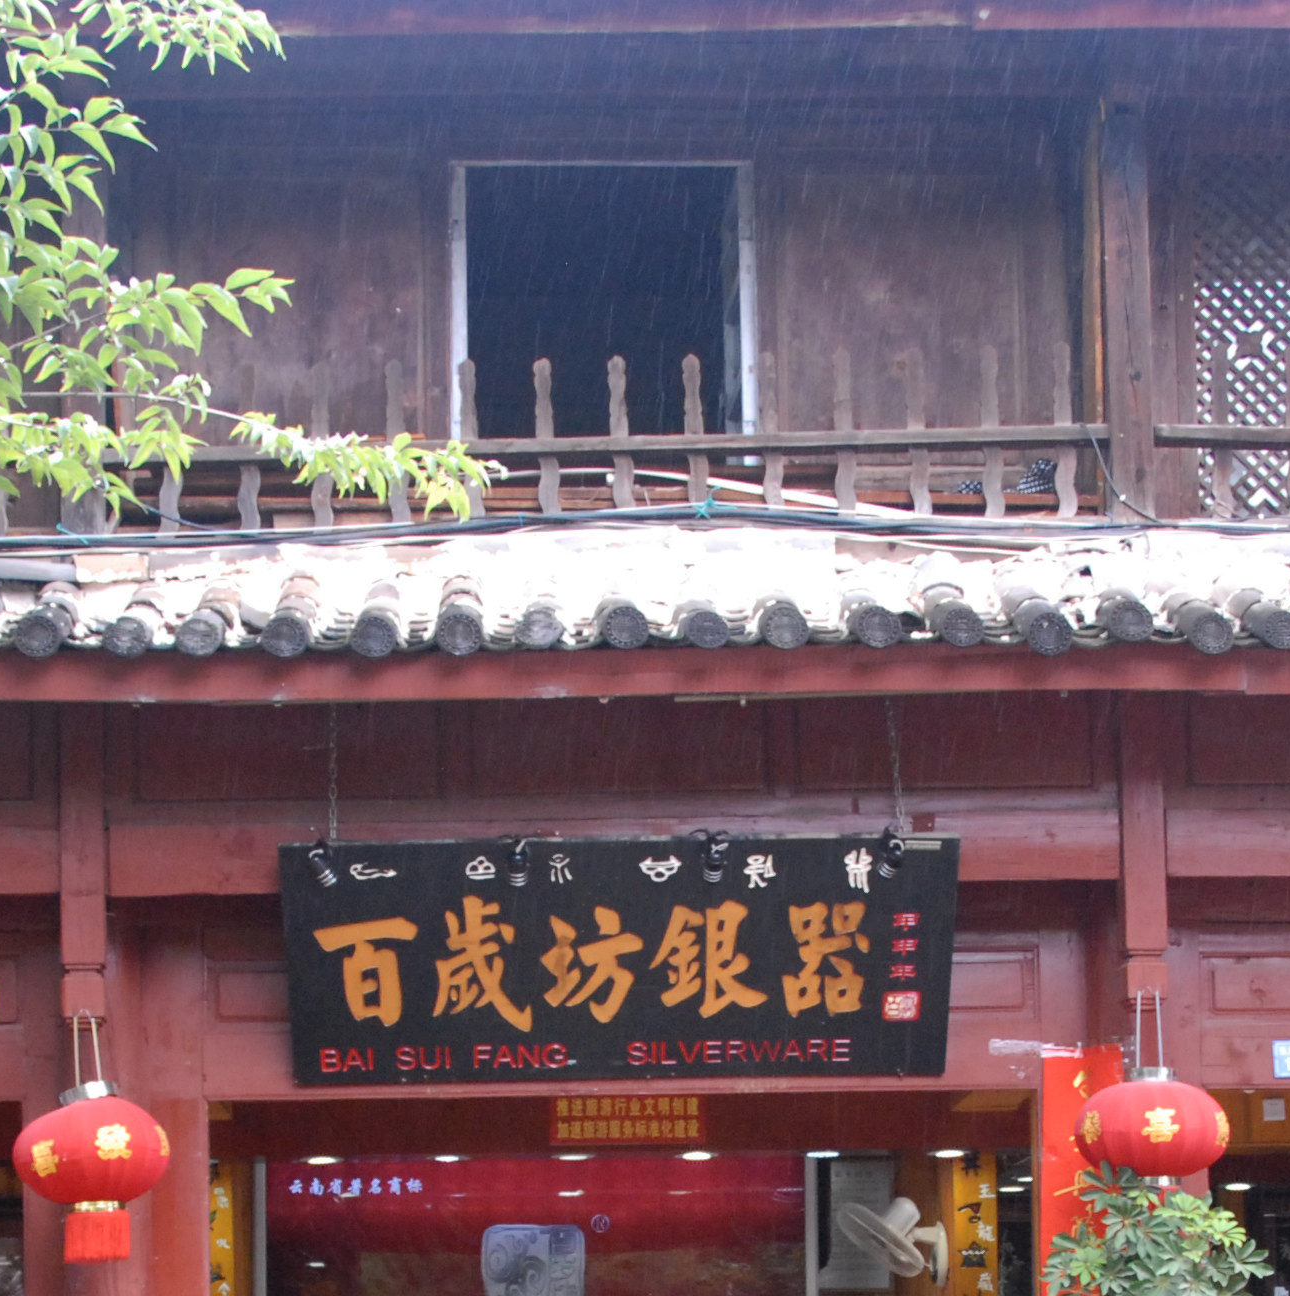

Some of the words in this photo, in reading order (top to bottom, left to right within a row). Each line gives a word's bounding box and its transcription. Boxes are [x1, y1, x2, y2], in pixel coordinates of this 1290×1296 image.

[312, 895, 870, 1033] 百歲坊銀器
[319, 1048, 374, 1073] BAI
[396, 1046, 452, 1070] SUI
[473, 1043, 567, 1069] FANG
[627, 1039, 851, 1065] SILVERWARE
[1141, 1107, 1181, 1144] 喜
